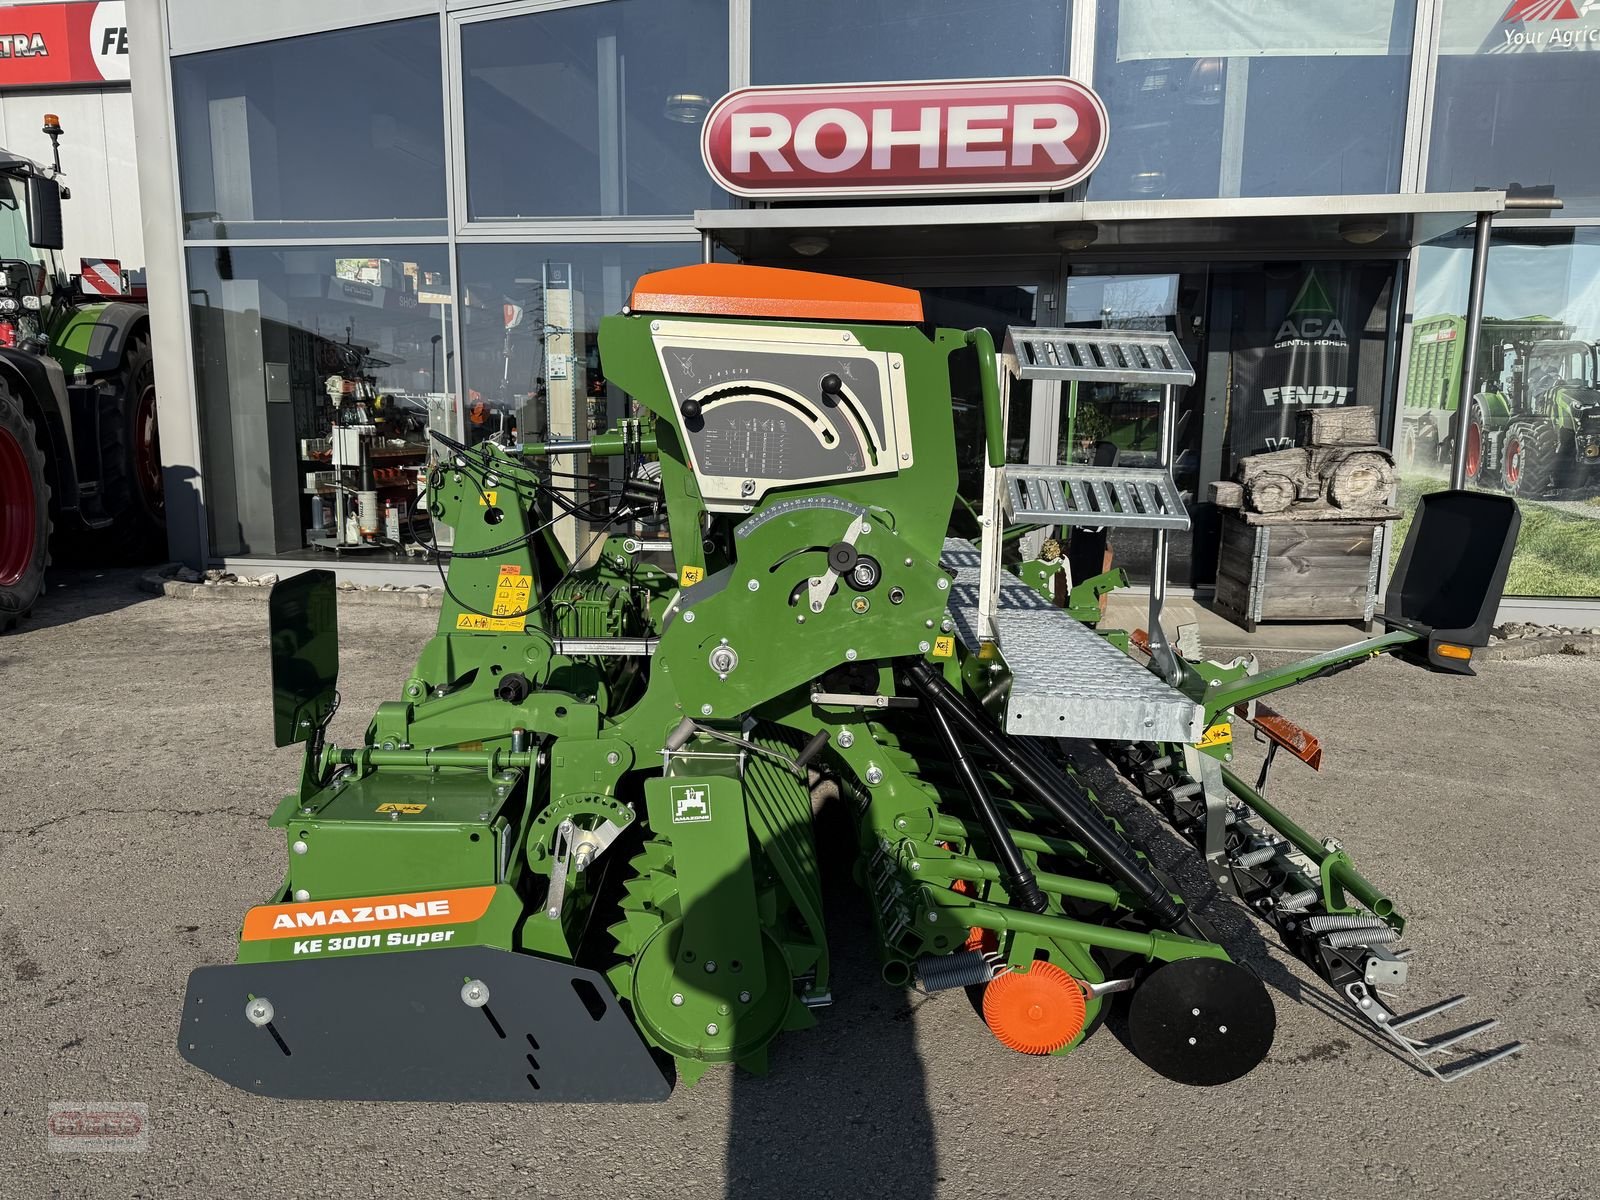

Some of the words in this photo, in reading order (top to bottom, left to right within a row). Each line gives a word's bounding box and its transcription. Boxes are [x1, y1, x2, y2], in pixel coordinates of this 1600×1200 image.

[1504, 28, 1544, 46] Your
[1548, 25, 1600, 47] Agric
[731, 104, 1079, 174] ROHER
[1275, 318, 1347, 340] ACA
[1274, 339, 1310, 349] CENTER
[1314, 339, 1347, 347] ROHER
[1263, 385, 1354, 406] FENDT
[272, 899, 450, 930] AMAZONE
[293, 939, 323, 955] KE
[328, 934, 381, 951] 3001
[386, 930, 455, 948] Super
